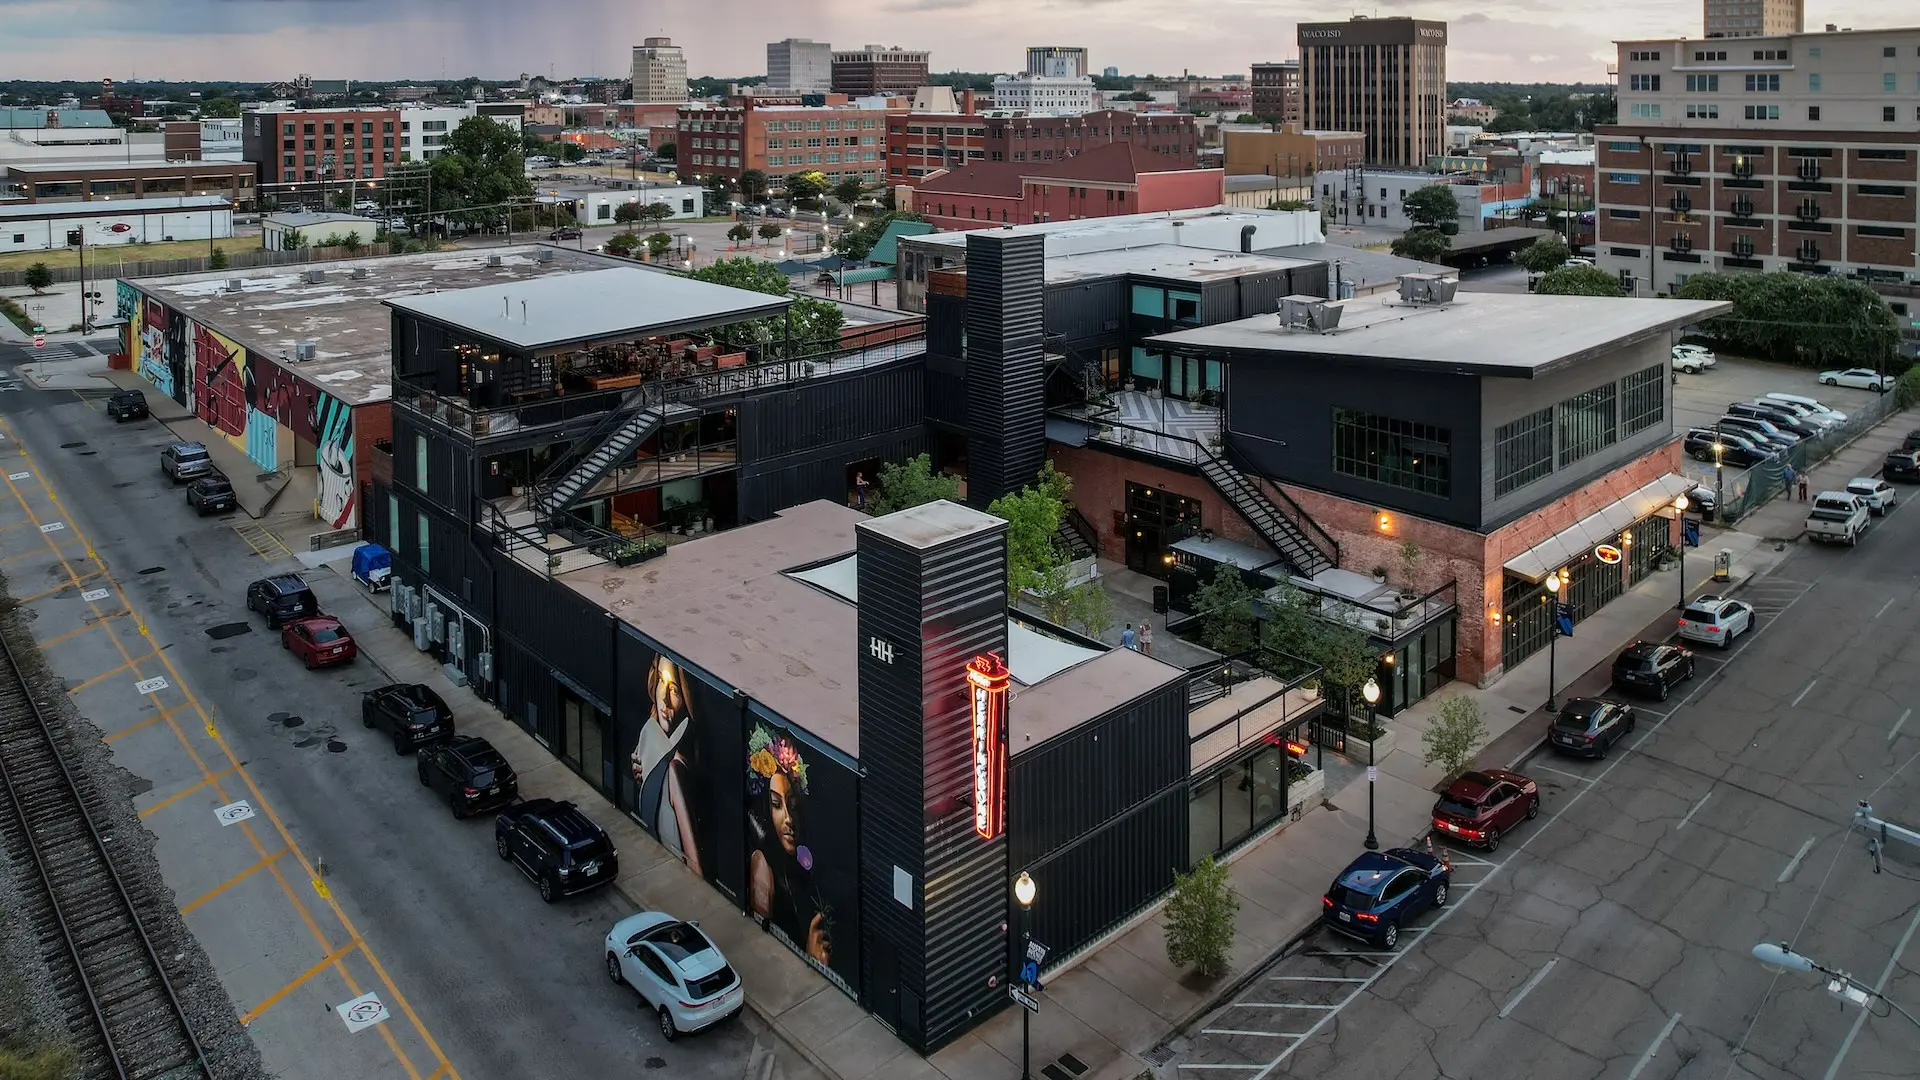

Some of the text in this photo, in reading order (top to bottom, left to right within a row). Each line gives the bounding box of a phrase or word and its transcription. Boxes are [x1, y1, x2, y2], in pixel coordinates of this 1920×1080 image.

[1302, 30, 1341, 38] WACO ISD
[869, 636, 895, 665] HH
[1287, 742, 1306, 755] LOBBY
